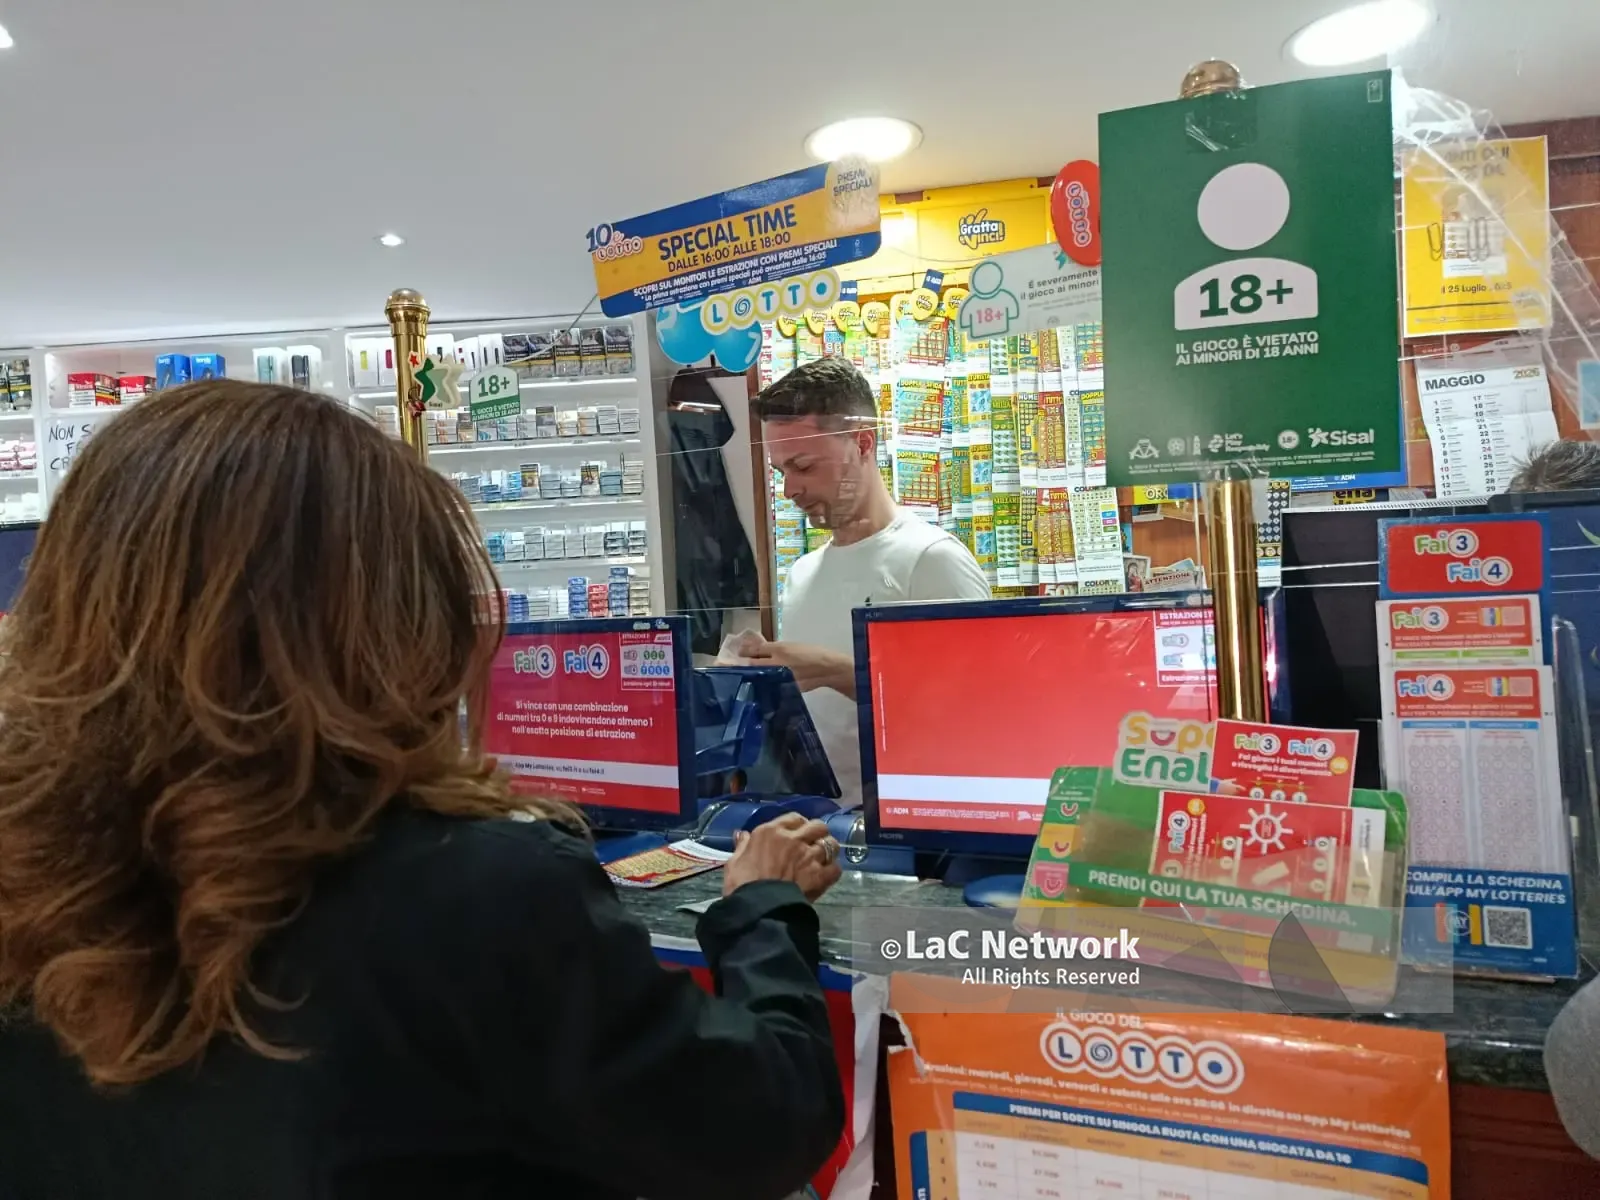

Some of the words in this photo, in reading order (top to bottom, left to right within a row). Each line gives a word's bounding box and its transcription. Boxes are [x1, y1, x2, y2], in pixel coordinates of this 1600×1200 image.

[1067, 183, 1092, 247] LOTTO
[658, 220, 741, 261] SPECIAL
[744, 204, 797, 237] TIME
[961, 221, 999, 235] Gratta
[668, 257, 699, 272] DALLE
[701, 247, 730, 265] 16:00
[733, 240, 757, 257] ALLE
[760, 231, 791, 250] 18:00
[633, 286, 659, 297] SCOPRI
[659, 281, 673, 290] SUL
[673, 272, 707, 287] MONITOR
[708, 268, 716, 277] LE
[717, 258, 759, 275] ESTRAZIONI
[760, 253, 778, 265] CON
[779, 247, 803, 260] PREMI
[804, 239, 838, 255] SPECIALI
[1037, 269, 1098, 288] severamente
[1028, 288, 1055, 300] gioco
[1057, 284, 1066, 293] ai
[1068, 279, 1100, 292] minori
[1199, 274, 1294, 318] 18+
[1447, 284, 1460, 294] 25
[1461, 283, 1487, 296] Luglio
[707, 275, 834, 329] LOTTO
[976, 307, 1004, 324] 18+
[1175, 343, 1189, 355] IL
[1192, 338, 1239, 354] GIOCO
[1242, 334, 1253, 349] È
[1256, 330, 1319, 349] VIETATO
[1175, 352, 1191, 366] AI
[1193, 349, 1243, 365] MINORI
[1245, 347, 1261, 360] DI
[1263, 346, 1281, 359] 18
[1282, 342, 1319, 357] ANNI
[477, 374, 510, 398] 18+
[1425, 373, 1486, 391] MAGGIO
[49, 423, 75, 443] NON
[1329, 428, 1375, 447] Sisal
[524, 700, 542, 710] vince
[543, 703, 557, 711] con
[558, 704, 572, 712] una
[573, 701, 628, 713] combinazione
[504, 713, 530, 723] numeri
[617, 714, 649, 727] almeno
[550, 726, 585, 739] posizione
[594, 728, 636, 740] estrazione
[1467, 874, 1484, 885] LA
[1488, 875, 1563, 890] SCHEDINA
[1088, 870, 1146, 892] PRENDI
[1150, 878, 1181, 898] QUI
[1186, 884, 1206, 902] LA
[1210, 889, 1248, 909] TUA
[1250, 897, 1358, 928] SCHEDINA.
[1466, 888, 1489, 899] MY
[1491, 889, 1567, 905] LOTTERIES
[1056, 1007, 1067, 1018] IL
[1070, 1009, 1115, 1025] GIOCO
[1047, 1028, 1238, 1087] LOTTO
[1229, 1101, 1240, 1113] in
[1242, 1103, 1284, 1119] diretta
[1303, 1113, 1329, 1127] app
[1330, 1116, 1352, 1132] My
[1352, 1119, 1411, 1139] Lotteries
[1009, 1103, 1042, 1118] PREMI
[1042, 1108, 1062, 1120] PER
[1202, 1132, 1230, 1146] CON
[1230, 1136, 1257, 1150] UNA
[1257, 1139, 1315, 1159] GIOCATA
[1315, 1149, 1336, 1163] DA
